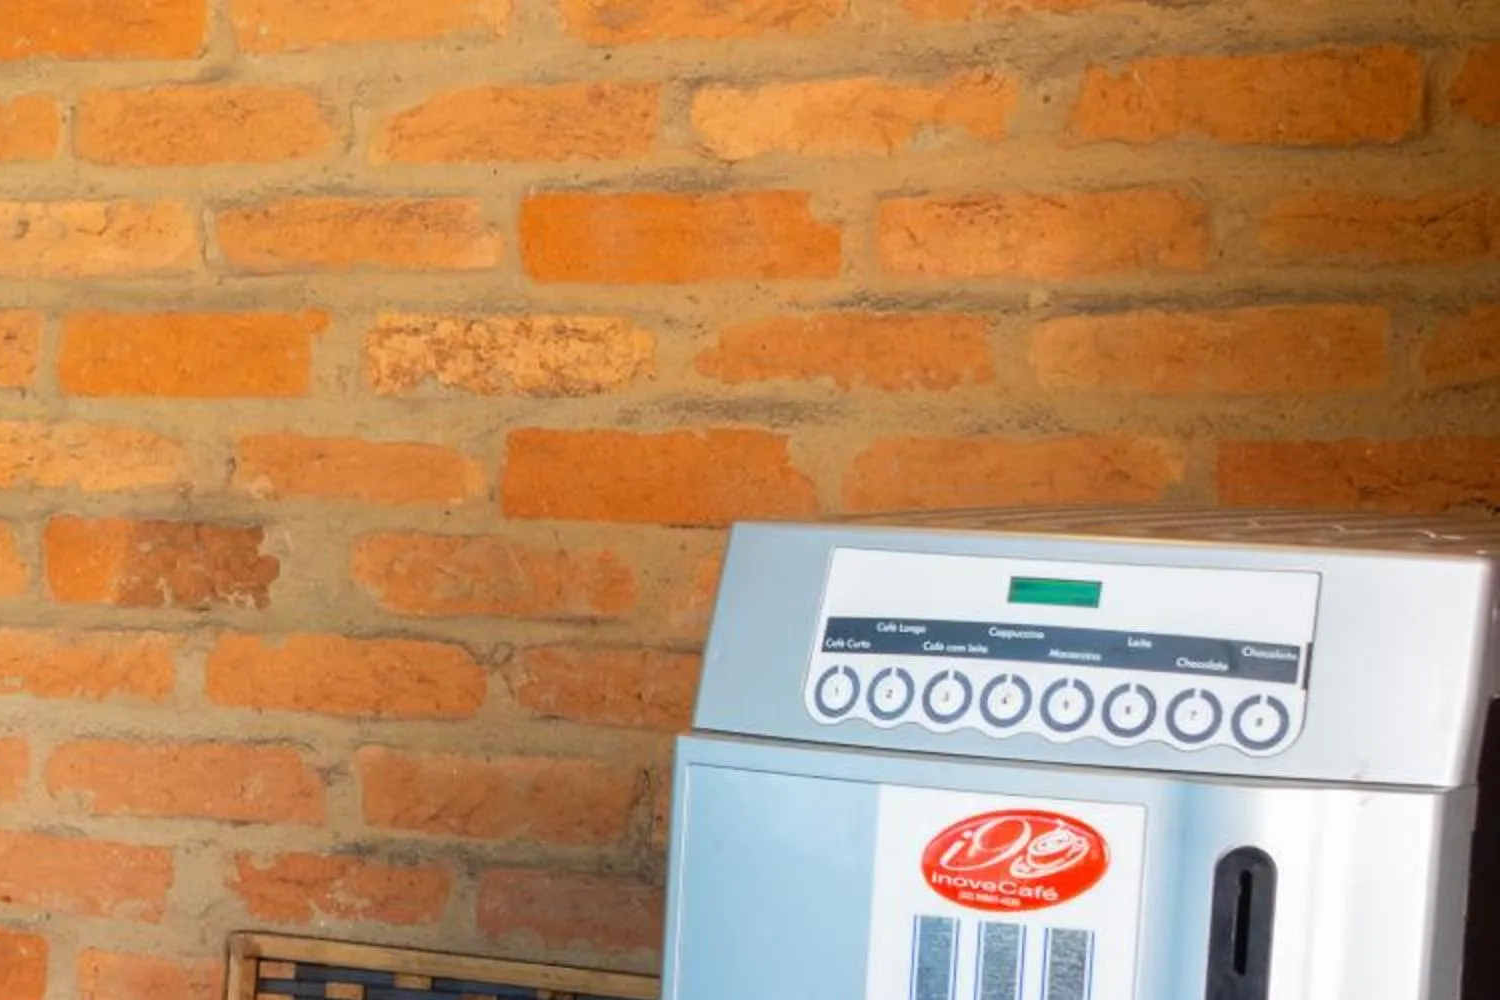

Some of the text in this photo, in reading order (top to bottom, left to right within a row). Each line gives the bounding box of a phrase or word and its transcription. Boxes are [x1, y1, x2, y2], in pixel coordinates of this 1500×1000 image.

[825, 638, 871, 650] Café Curto
[1127, 636, 1152, 649] Leite
[931, 871, 1060, 901] inoveCafé
